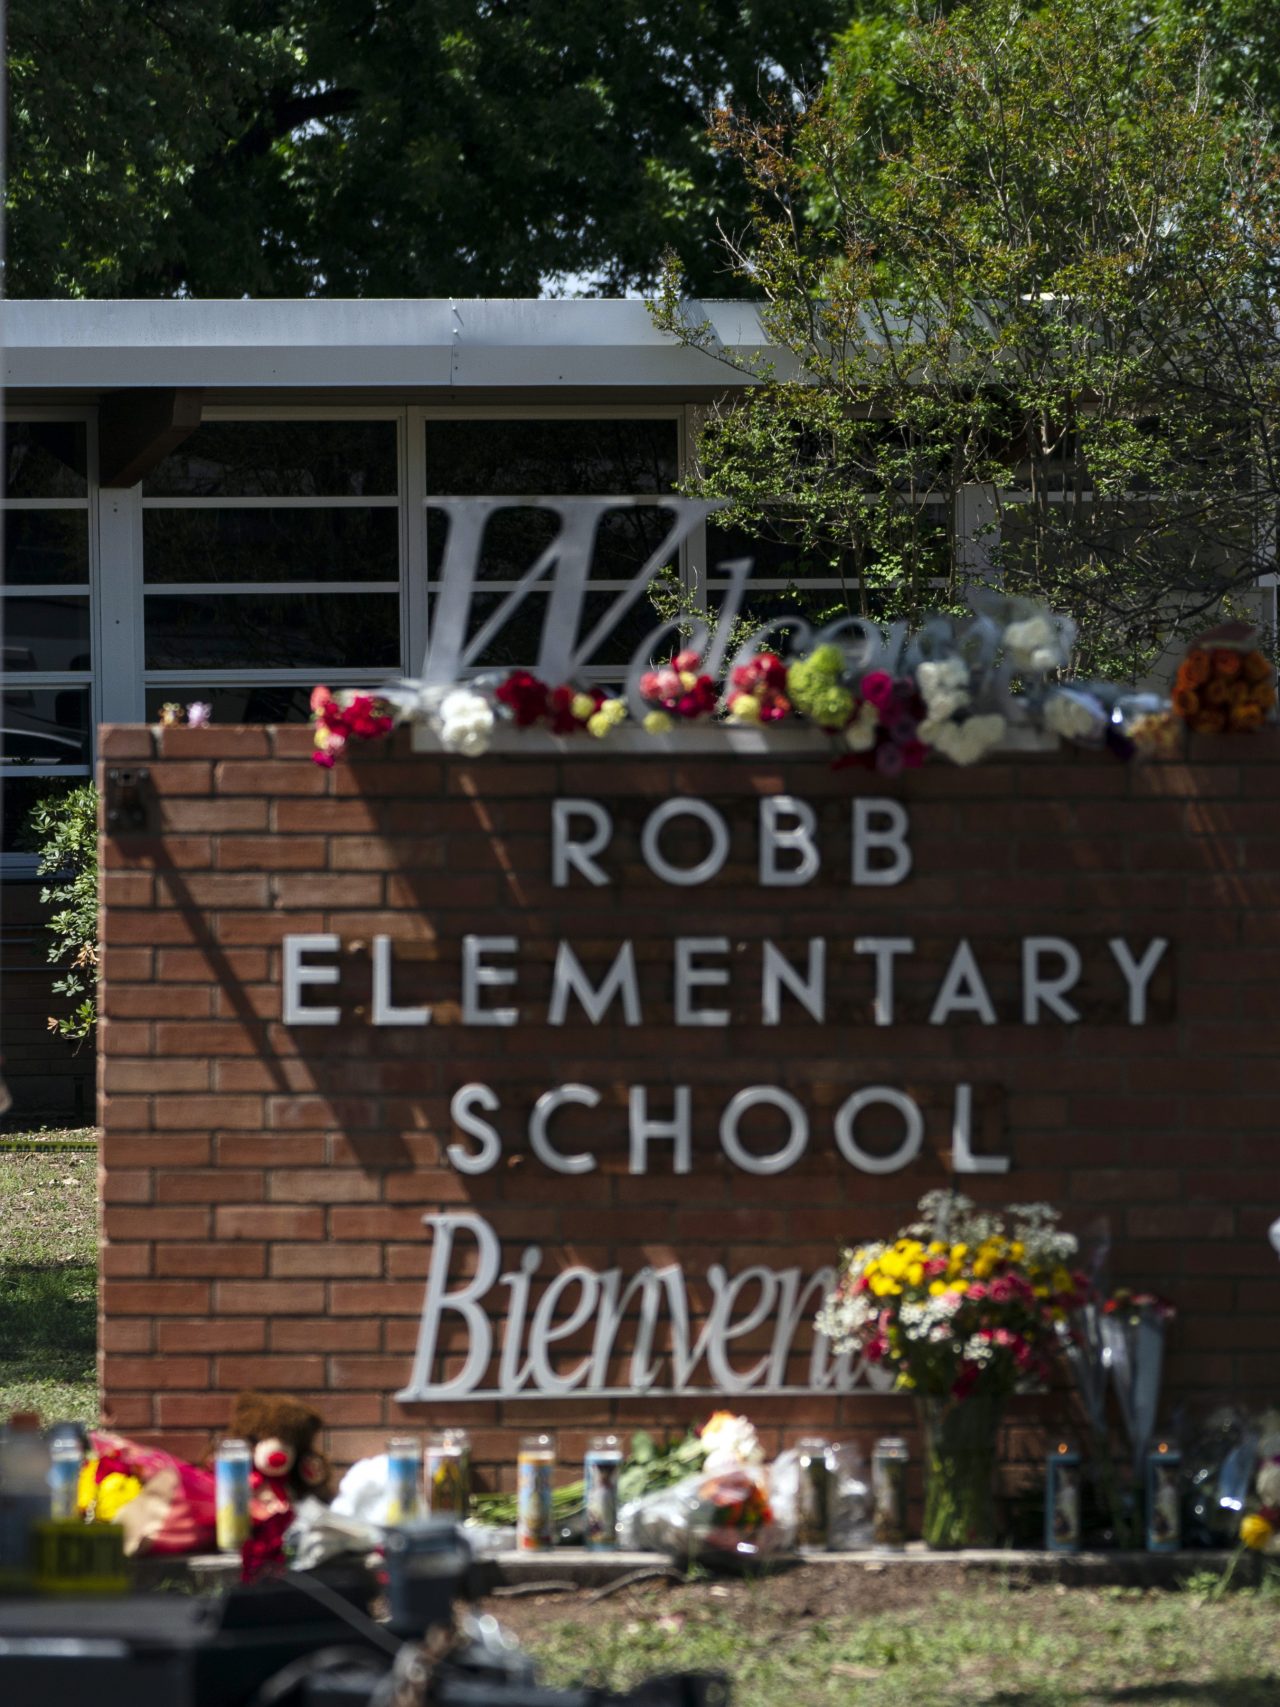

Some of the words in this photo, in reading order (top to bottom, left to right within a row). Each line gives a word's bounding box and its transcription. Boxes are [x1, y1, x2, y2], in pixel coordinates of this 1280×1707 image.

[551, 796, 913, 888] ROBB
[282, 934, 1168, 1026] ELEMENTARY
[447, 1083, 1010, 1175] SCHOOL
[398, 1212, 897, 1396] Bienven
